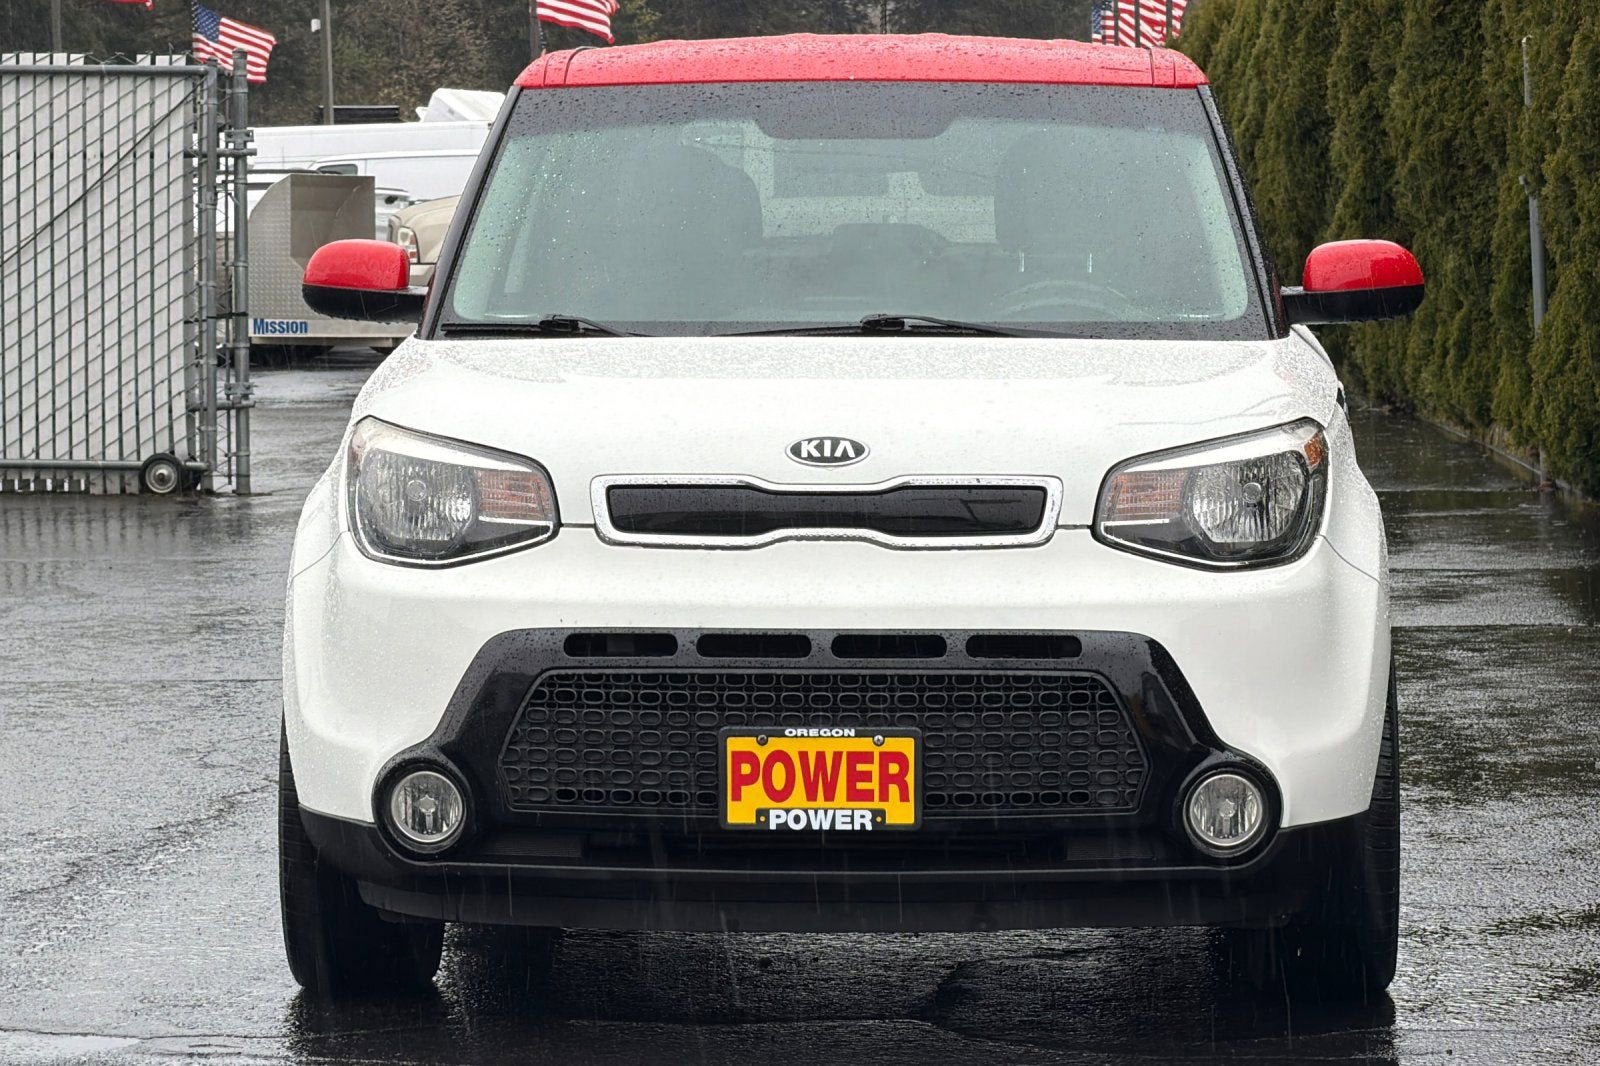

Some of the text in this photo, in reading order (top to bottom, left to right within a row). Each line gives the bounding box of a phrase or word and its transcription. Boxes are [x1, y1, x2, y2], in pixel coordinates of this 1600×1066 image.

[253, 318, 308, 335] Mission
[800, 439, 856, 458] KIA
[784, 728, 856, 737] OREGON
[730, 749, 910, 803] POWER
[769, 809, 873, 831] POWER
